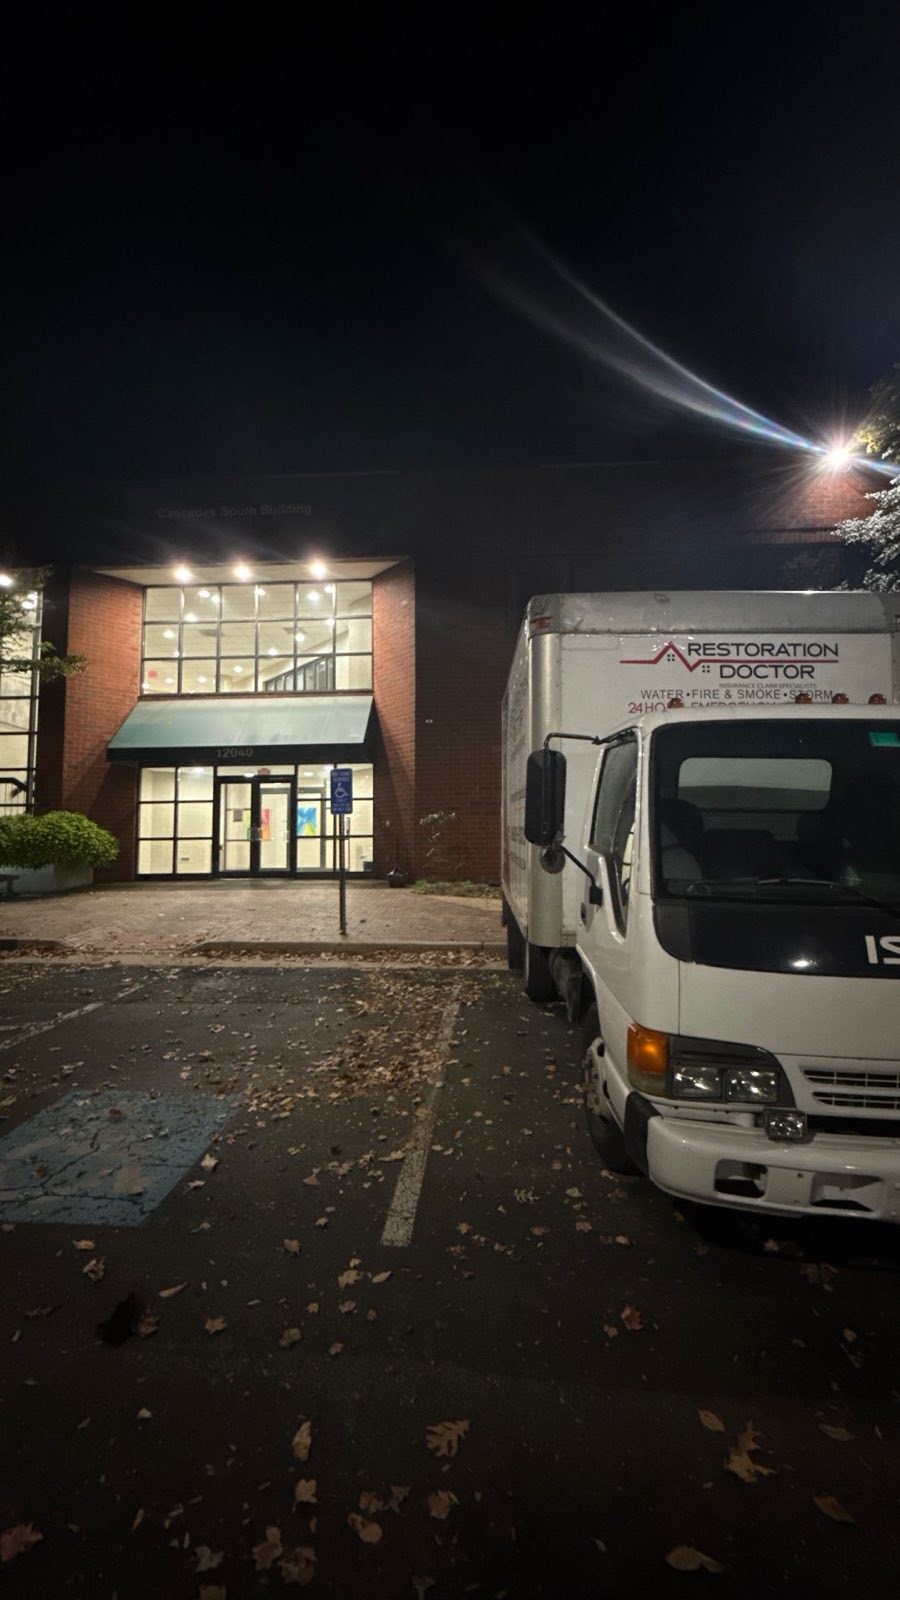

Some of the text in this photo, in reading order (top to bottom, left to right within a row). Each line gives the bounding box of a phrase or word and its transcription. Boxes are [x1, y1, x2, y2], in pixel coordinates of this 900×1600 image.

[220, 505, 257, 517] South
[260, 503, 312, 517] Building
[688, 642, 839, 657] RESTORATION
[720, 664, 815, 679] DOCTOR
[724, 689, 732, 699] &
[217, 748, 253, 758] 12040
